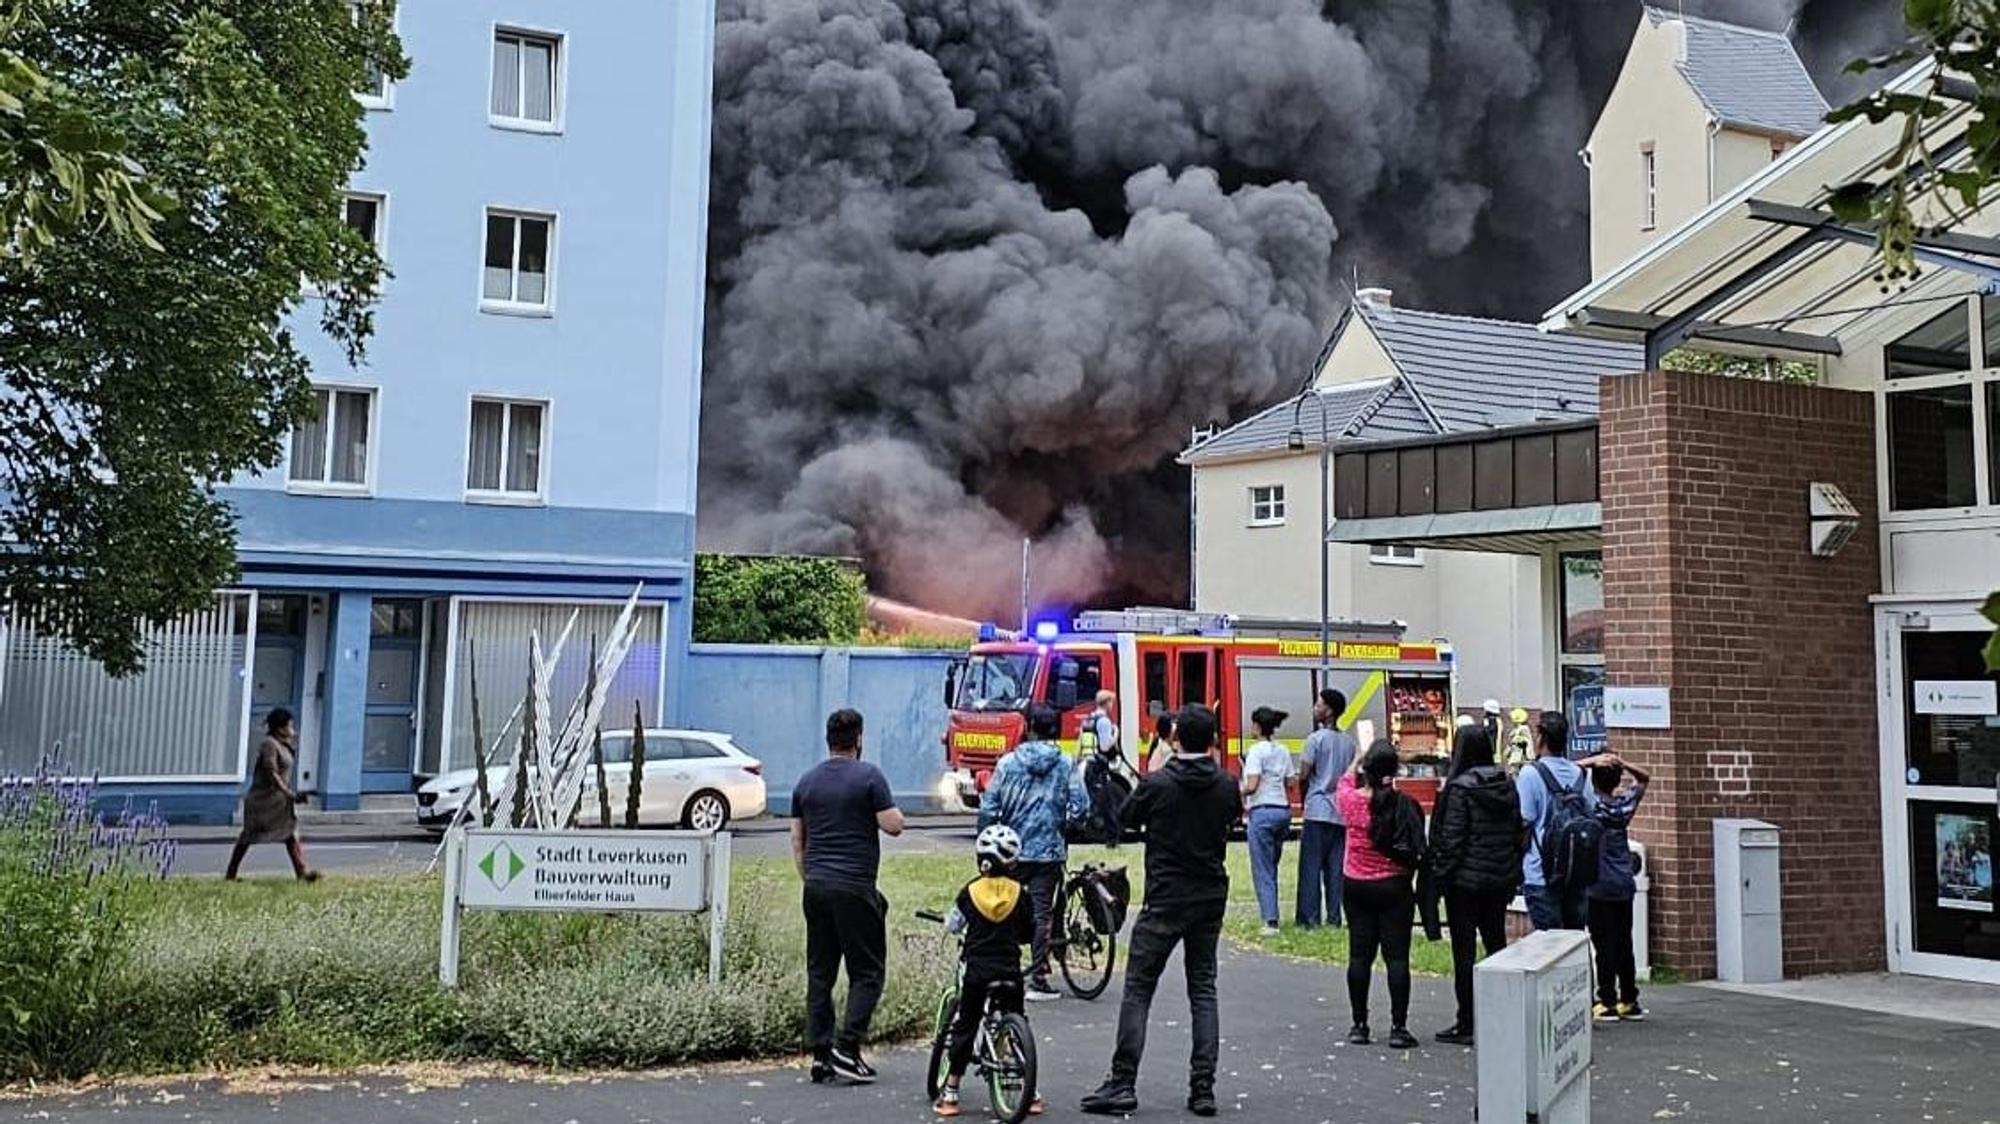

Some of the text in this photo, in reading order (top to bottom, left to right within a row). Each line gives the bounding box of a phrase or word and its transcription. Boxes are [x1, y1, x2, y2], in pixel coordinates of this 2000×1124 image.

[954, 732, 1006, 750] FEUERWEHR
[536, 845, 688, 866] Stadt Leverkusen
[535, 867, 671, 890] Bauverwaltung
[534, 888, 636, 903] Elberfelder Haus
